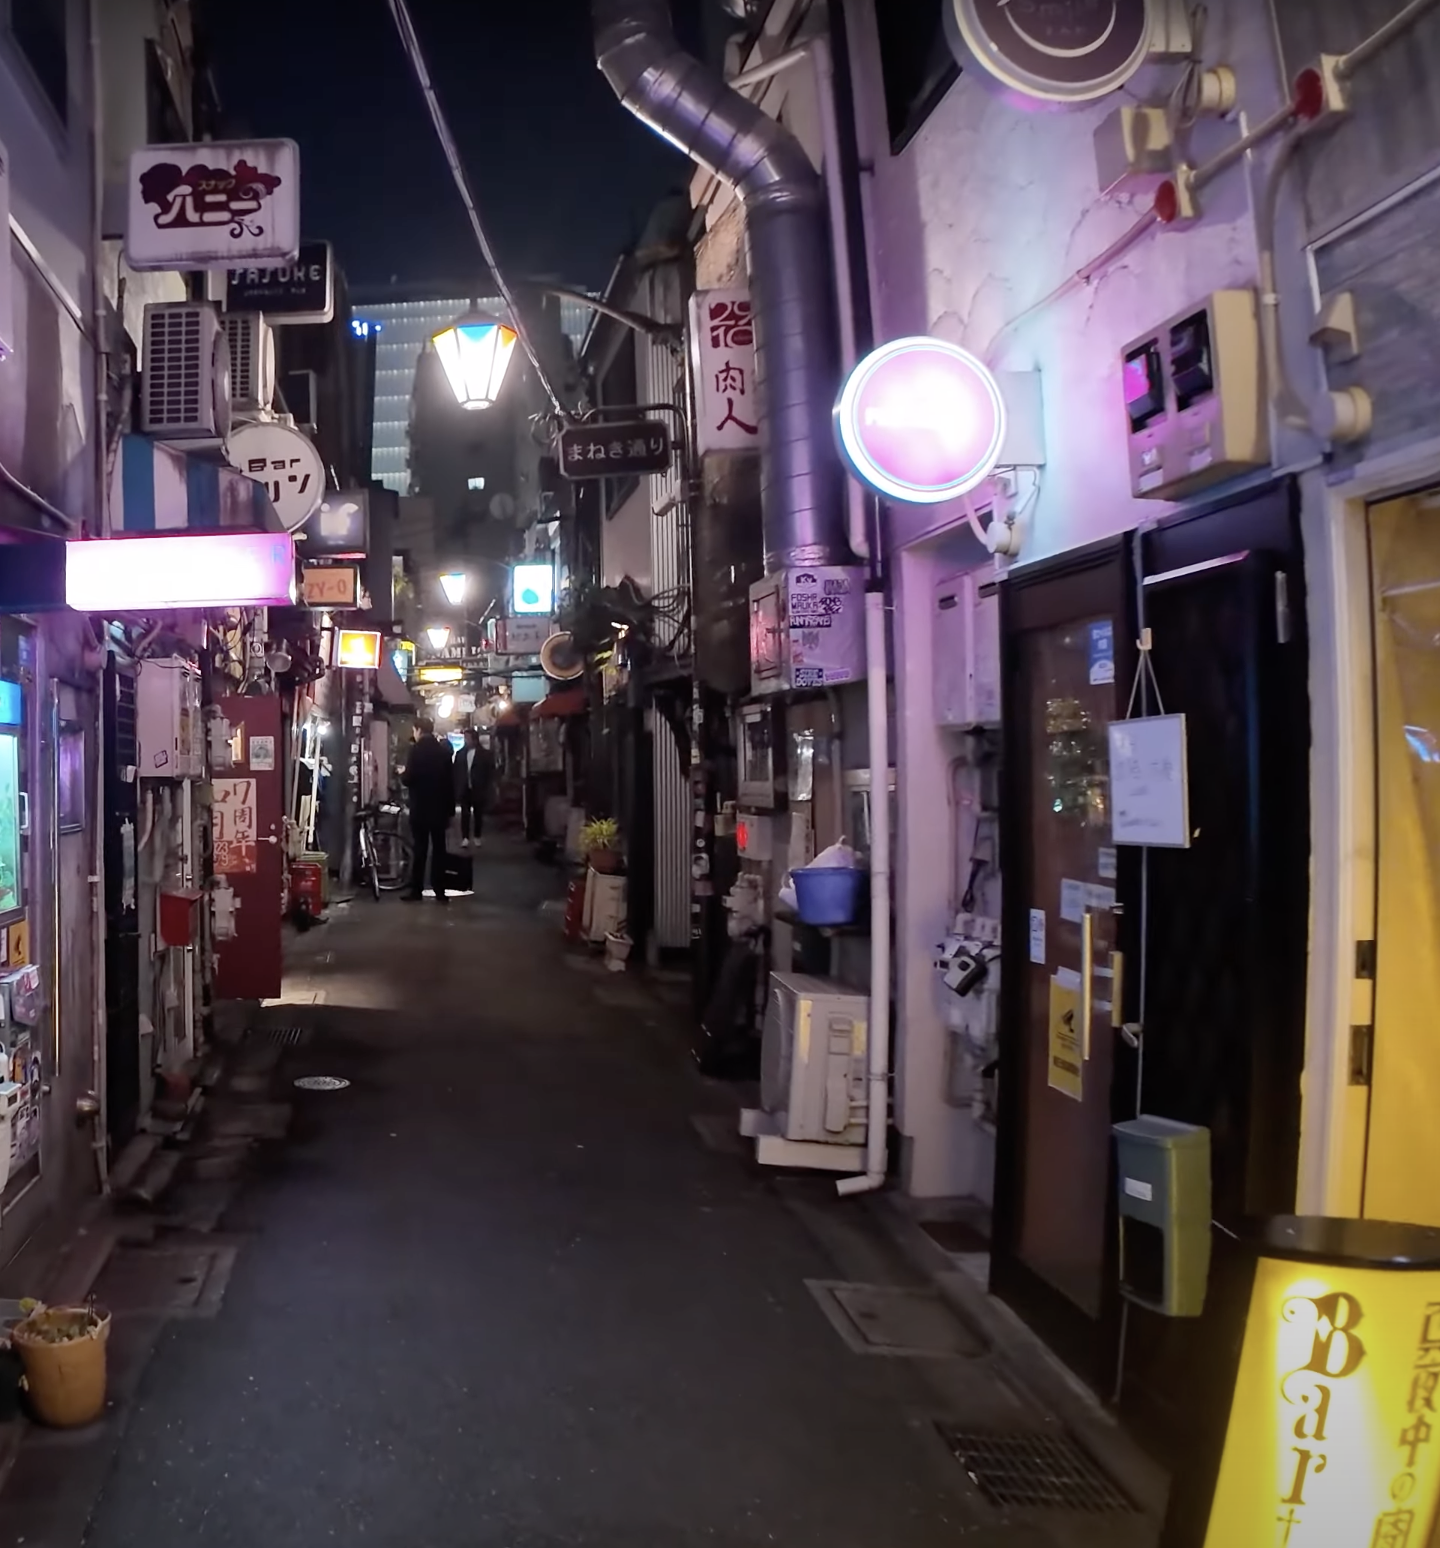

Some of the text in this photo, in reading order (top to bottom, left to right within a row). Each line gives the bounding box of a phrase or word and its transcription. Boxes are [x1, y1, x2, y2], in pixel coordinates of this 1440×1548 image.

[157, 185, 260, 225] ハニー
[568, 437, 663, 461] まねき通り
[248, 458, 301, 473] Bar
[1282, 1291, 1367, 1506] Bar
